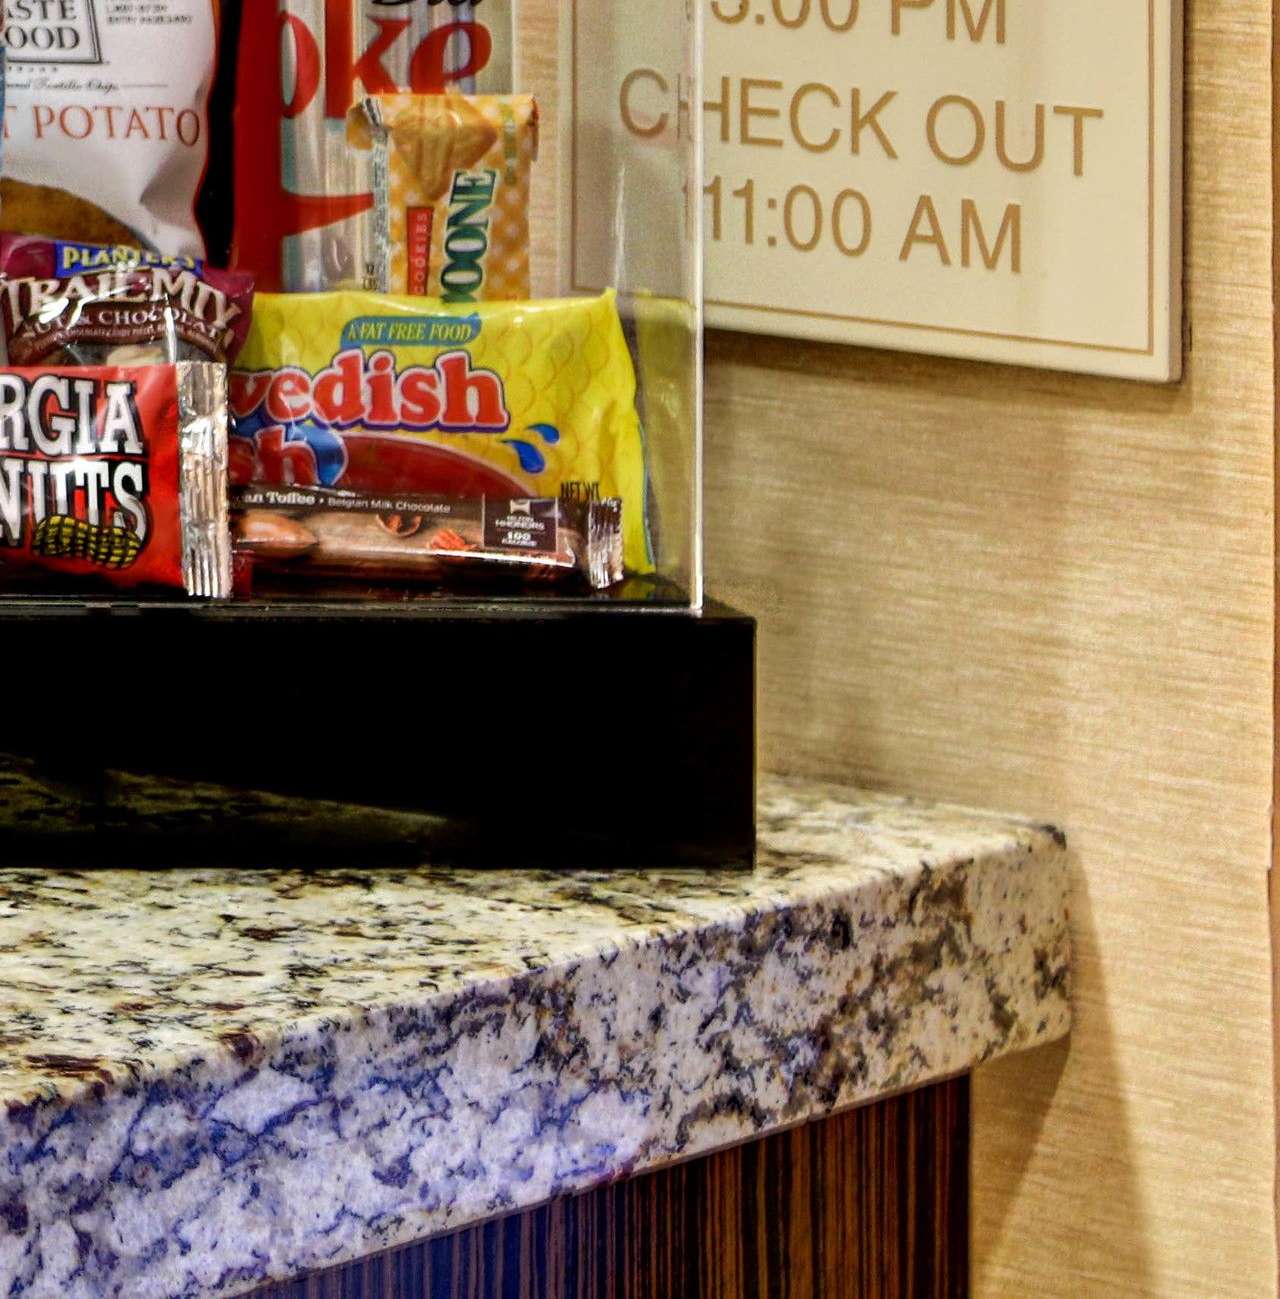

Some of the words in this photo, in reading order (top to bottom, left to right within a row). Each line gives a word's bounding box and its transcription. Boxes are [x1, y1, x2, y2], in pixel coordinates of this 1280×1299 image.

[4, 25, 81, 50] OOD
[35, 104, 200, 148] POTATO
[620, 68, 898, 161] CHECK
[926, 95, 1103, 177] OUT
[899, 194, 1022, 274] AM
[359, 323, 385, 340] FAT
[389, 323, 424, 340] FREE
[430, 323, 472, 341] FOOD
[229, 348, 509, 430] wedish
[266, 491, 315, 504] Toffee
